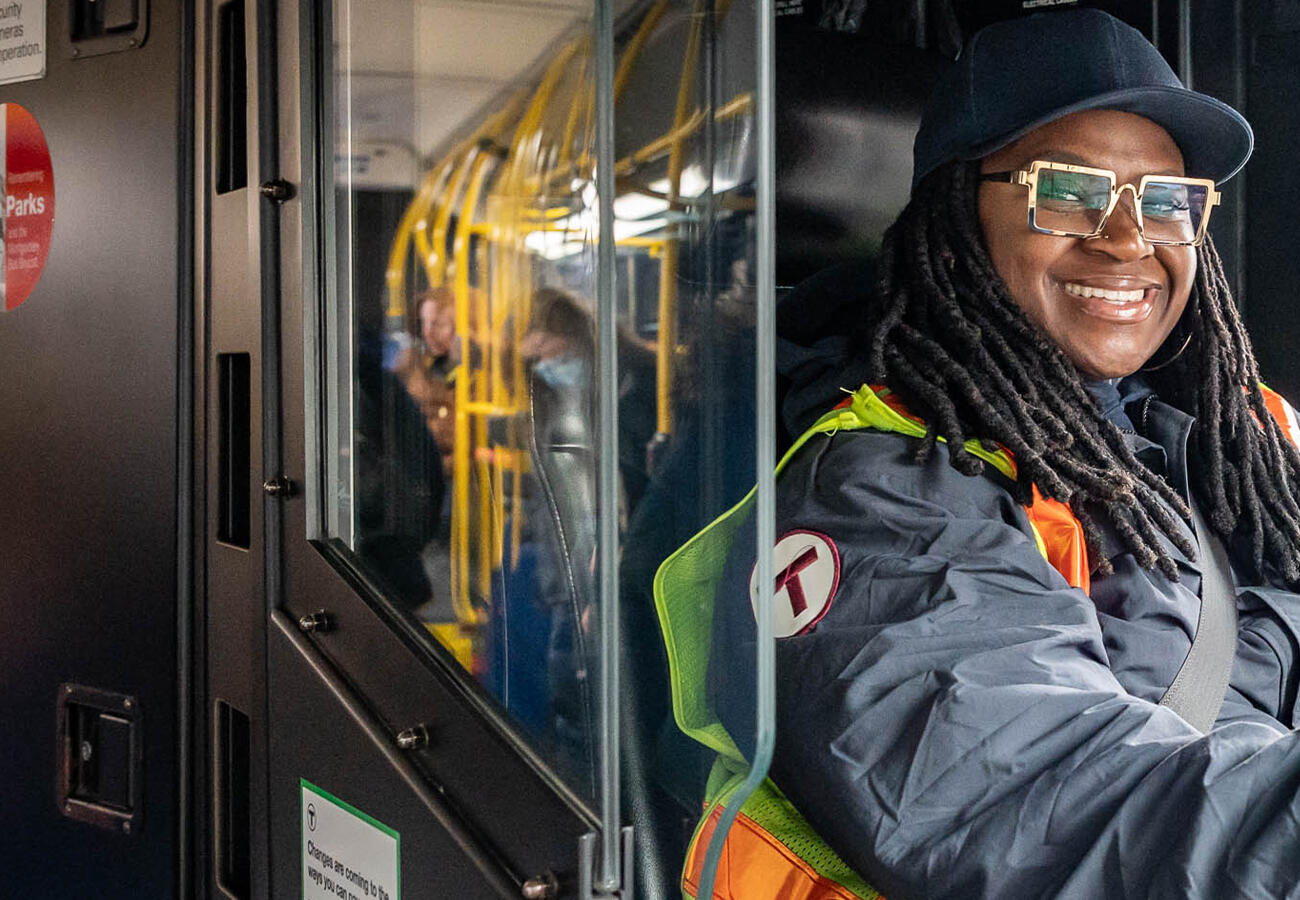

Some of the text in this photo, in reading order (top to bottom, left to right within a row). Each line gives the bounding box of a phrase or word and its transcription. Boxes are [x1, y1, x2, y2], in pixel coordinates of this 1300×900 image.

[6, 193, 45, 217] Parks
[757, 545, 818, 618] T
[307, 840, 333, 869] Changes
[334, 860, 344, 876] are
[345, 867, 369, 896] coming
[371, 880, 378, 898] to
[379, 884, 390, 900] the
[307, 866, 323, 886] ways
[323, 875, 336, 894] you
[335, 884, 348, 900] can
